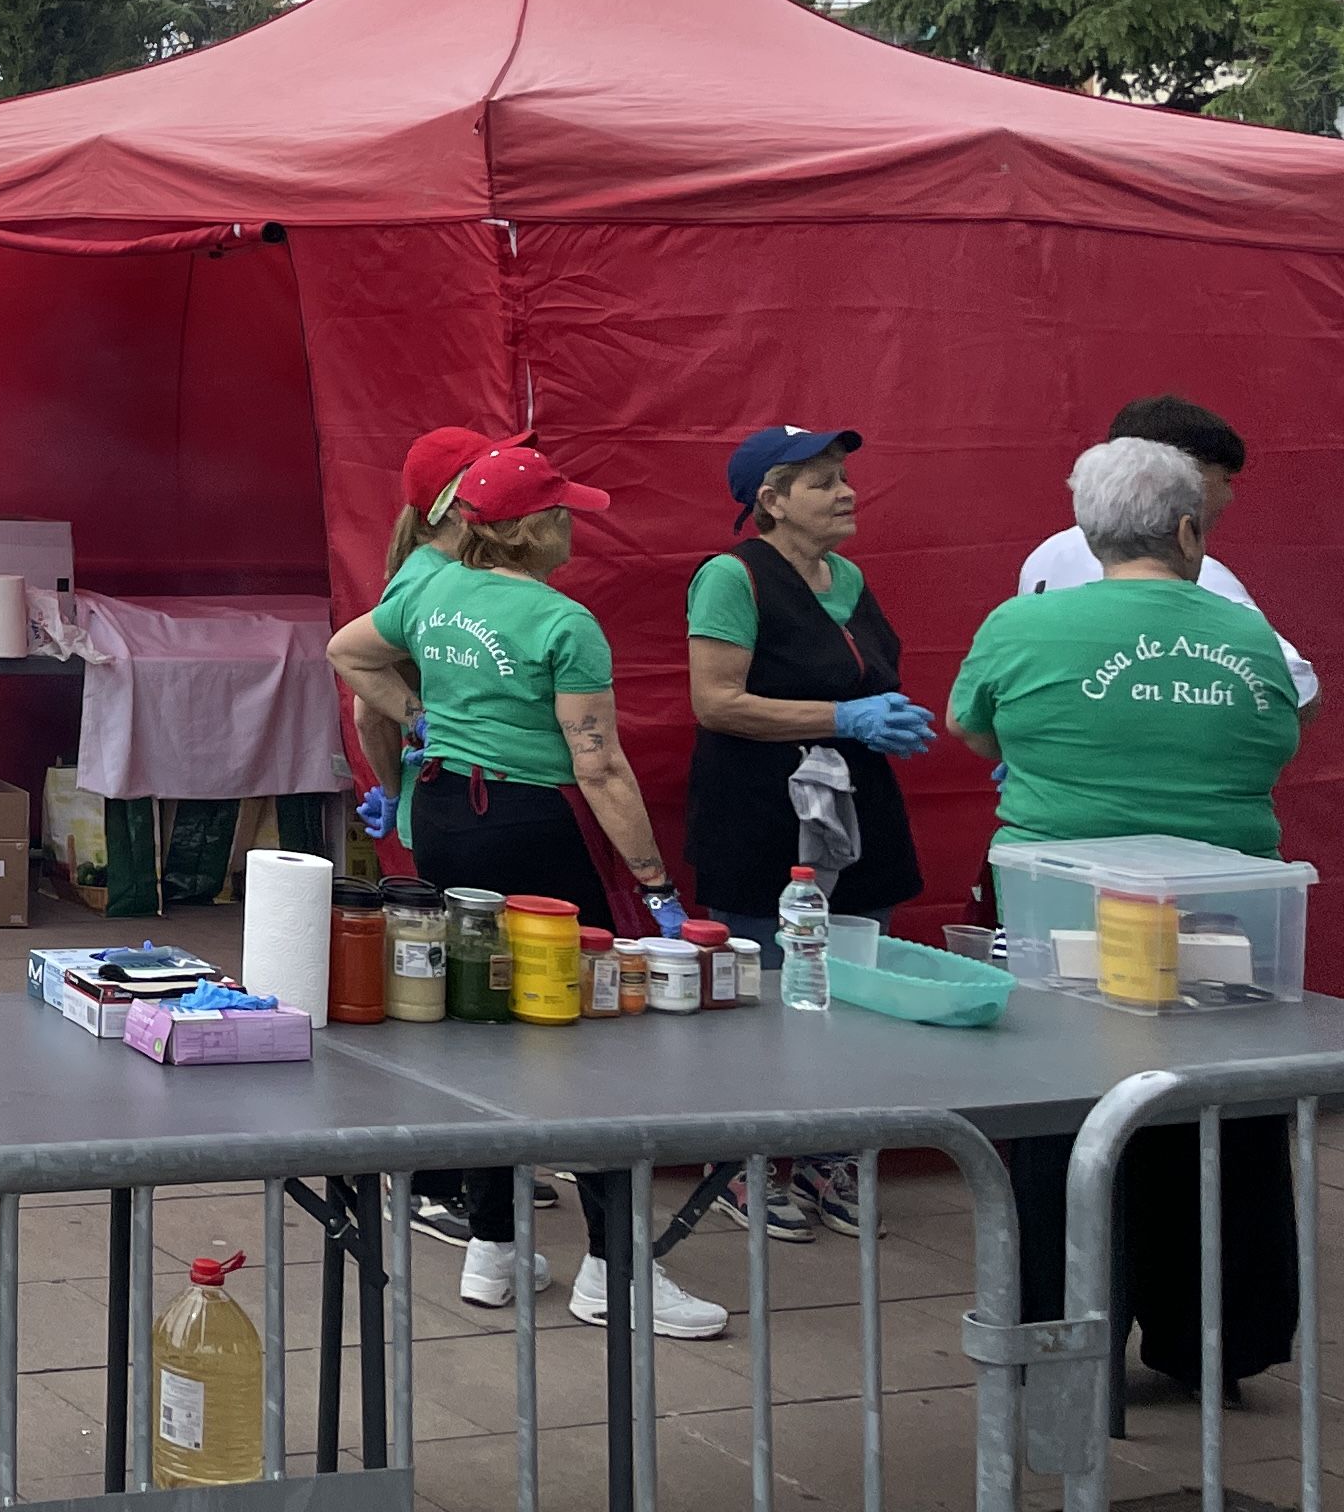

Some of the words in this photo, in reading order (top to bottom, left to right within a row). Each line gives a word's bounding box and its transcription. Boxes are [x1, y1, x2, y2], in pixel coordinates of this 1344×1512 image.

[429, 607, 446, 628] de
[448, 611, 517, 676] Andalucía
[424, 646, 441, 660] en
[446, 646, 480, 669] Rubí
[1082, 651, 1132, 699] Casa
[1136, 634, 1165, 661] de
[1131, 682, 1163, 701] en
[1172, 681, 1235, 706] Rubí
[29, 958, 42, 984] M
